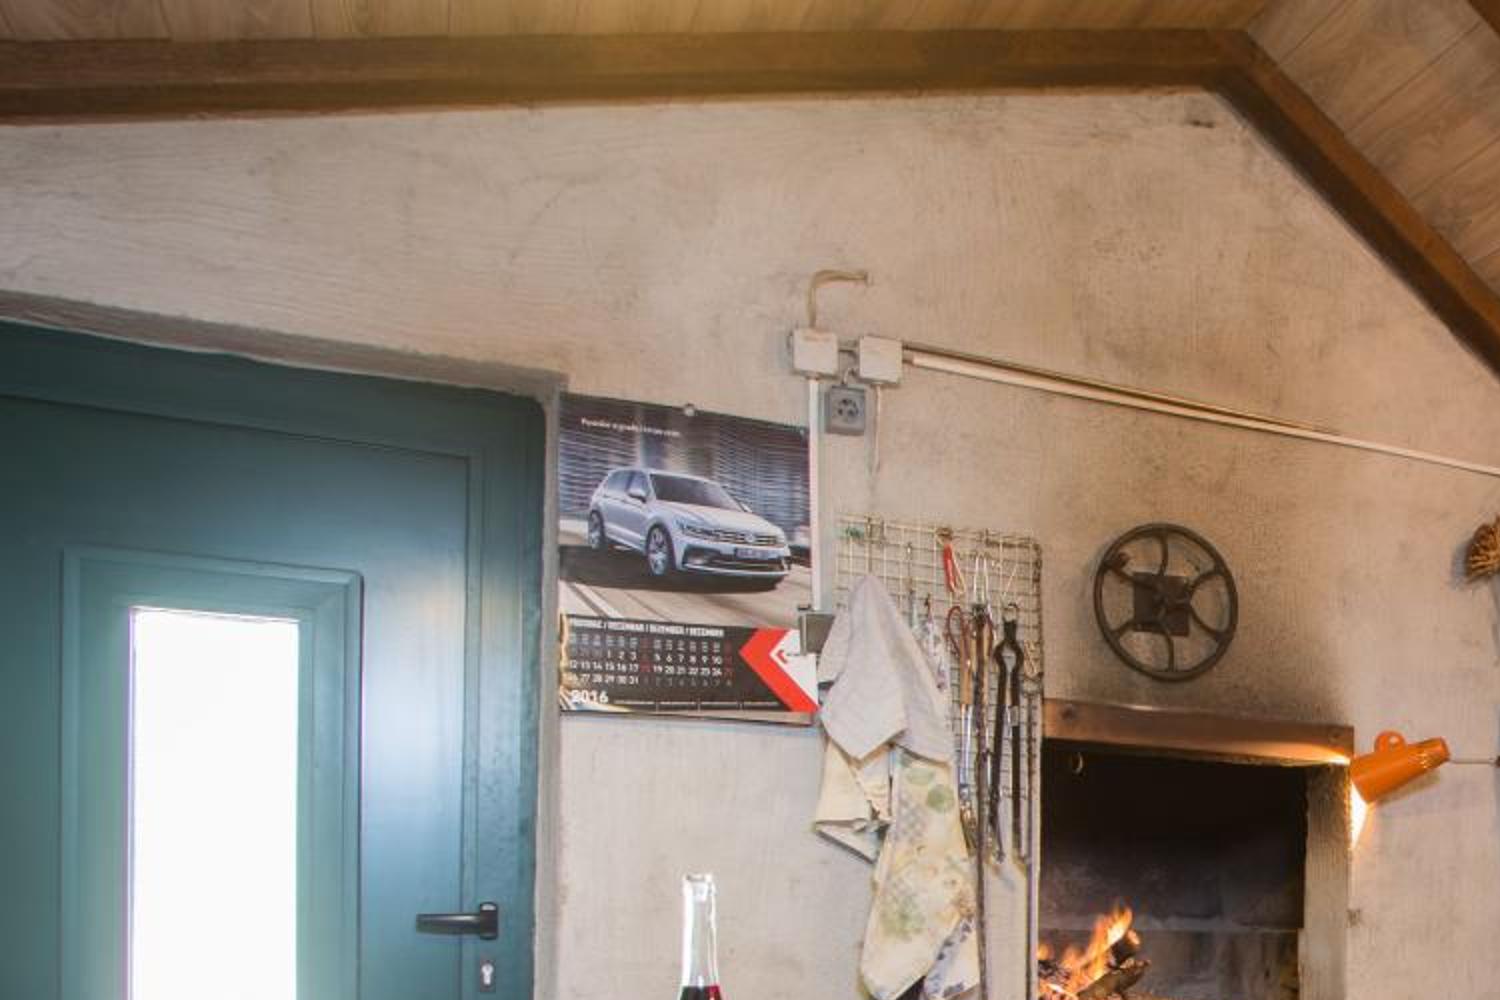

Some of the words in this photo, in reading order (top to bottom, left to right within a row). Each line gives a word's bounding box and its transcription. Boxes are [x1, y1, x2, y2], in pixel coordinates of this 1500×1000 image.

[712, 656, 723, 665] 10
[593, 662, 603, 670] 14
[605, 662, 615, 671] 15
[617, 663, 626, 672] 16
[630, 663, 639, 672] 17
[654, 665, 663, 673] 19
[665, 665, 674, 674] 20
[629, 675, 639, 685] 31
[571, 690, 609, 704] 2016
